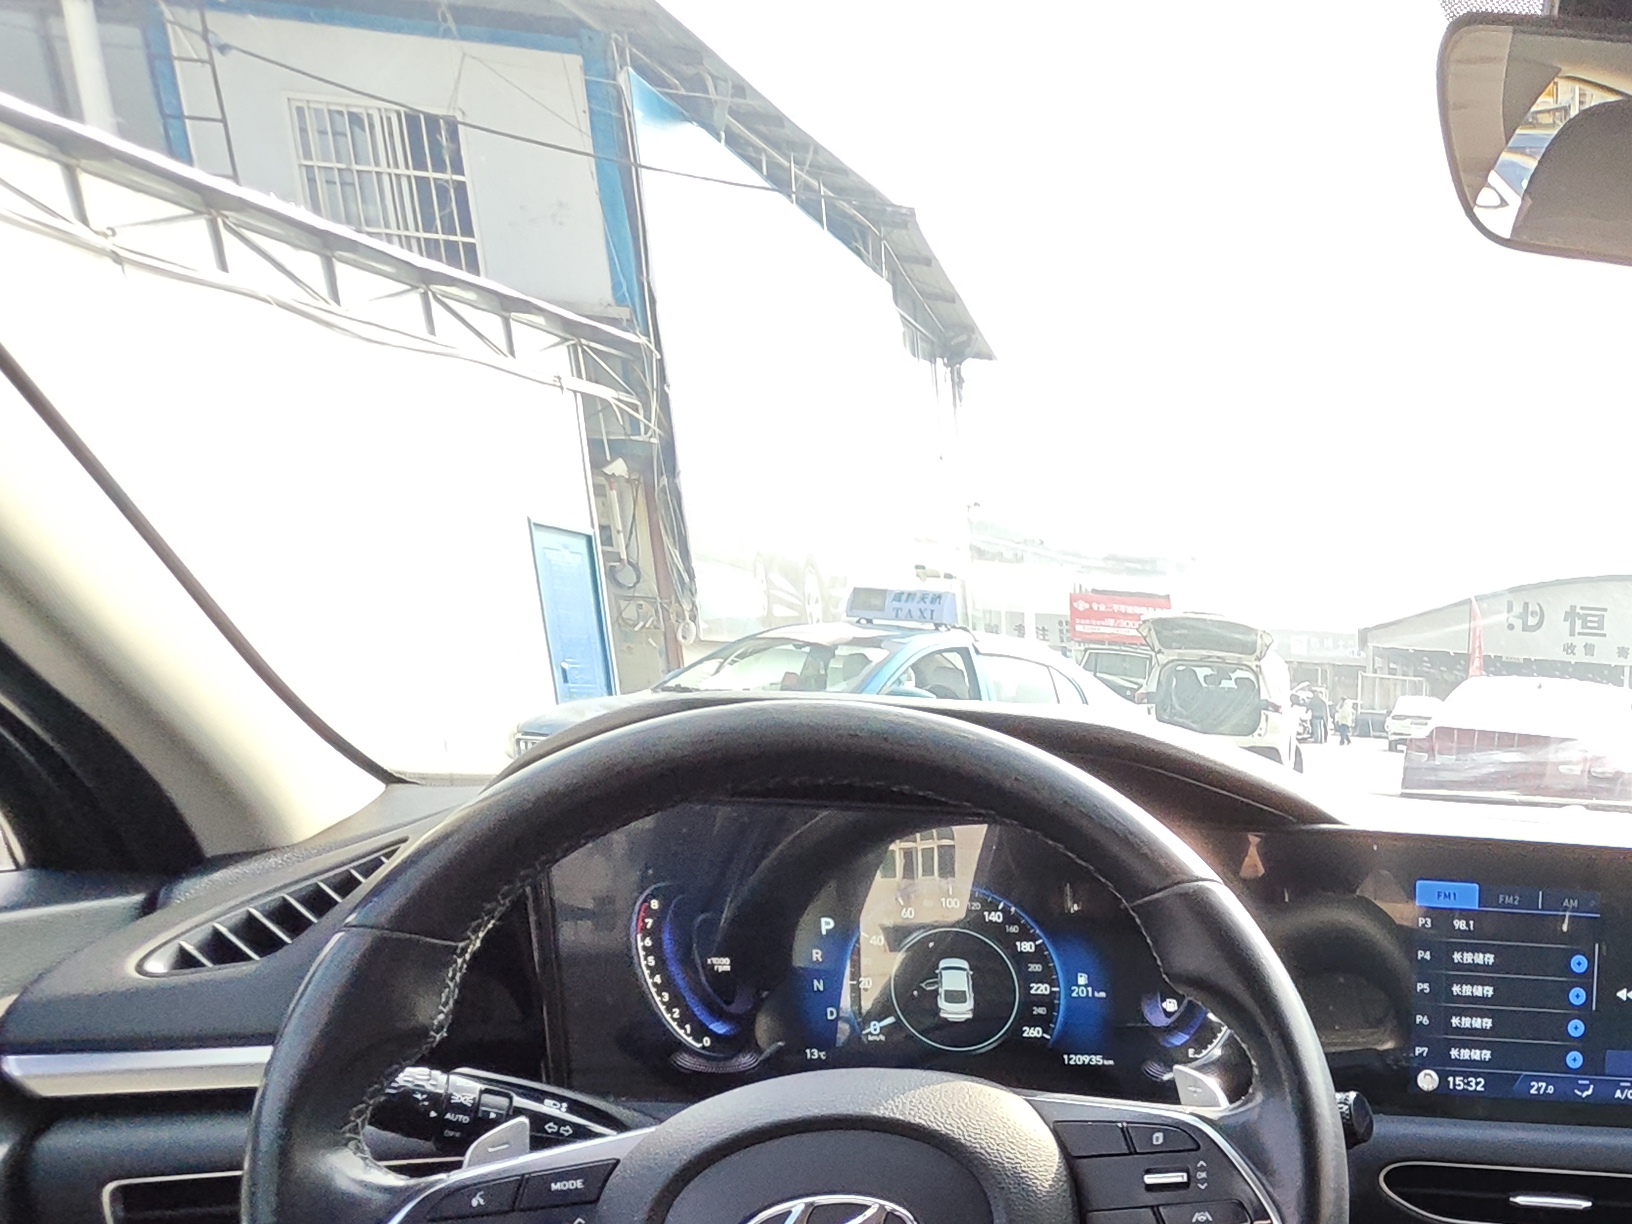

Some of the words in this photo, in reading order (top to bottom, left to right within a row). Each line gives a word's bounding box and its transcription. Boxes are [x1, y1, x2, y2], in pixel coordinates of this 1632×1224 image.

[892, 607, 934, 620] TAXI
[1563, 642, 1595, 658] 收售
[1437, 891, 1457, 902] FM1
[1499, 895, 1520, 905] FM2
[650, 900, 659, 910] 8
[941, 898, 960, 908] 100
[968, 902, 981, 910] 120
[1562, 898, 1578, 908] AM
[901, 909, 915, 919] 60
[984, 911, 1003, 923] 140
[645, 919, 653, 928] 7
[821, 917, 835, 935] P
[1005, 924, 1020, 933] 160
[1418, 917, 1432, 928] P3
[1453, 919, 1475, 932] 98.1
[644, 937, 652, 946] 6
[870, 935, 885, 947] 40
[1016, 942, 1035, 953] 180
[812, 949, 822, 961] R
[1417, 950, 1431, 961] P4
[1452, 951, 1495, 966] 长按储存
[648, 957, 655, 966] 5
[714, 964, 731, 973] rpm
[1028, 964, 1043, 972] 200
[653, 975, 661, 984] 4
[859, 978, 872, 988] 20
[814, 979, 824, 991] N
[1030, 984, 1050, 995] 220
[1416, 983, 1430, 993] P5
[1451, 983, 1494, 998] 长按储存
[662, 992, 670, 1002] 3
[672, 1009, 680, 1018] 2
[827, 1008, 837, 1019] D
[1033, 1007, 1047, 1015] 240
[1416, 1015, 1429, 1025] P6
[1450, 1015, 1493, 1030] 长按储存
[684, 1025, 690, 1034] 1
[1022, 1028, 1043, 1038] 260
[703, 1037, 711, 1047] 0
[1188, 1049, 1196, 1059] E
[1415, 1047, 1428, 1057] P7
[1449, 1047, 1492, 1062] 长按储存
[1447, 1075, 1485, 1091] 15:32
[1530, 1081, 1555, 1095] 27.0
[444, 1112, 470, 1123] AUTO
[550, 1179, 585, 1192] MODE
